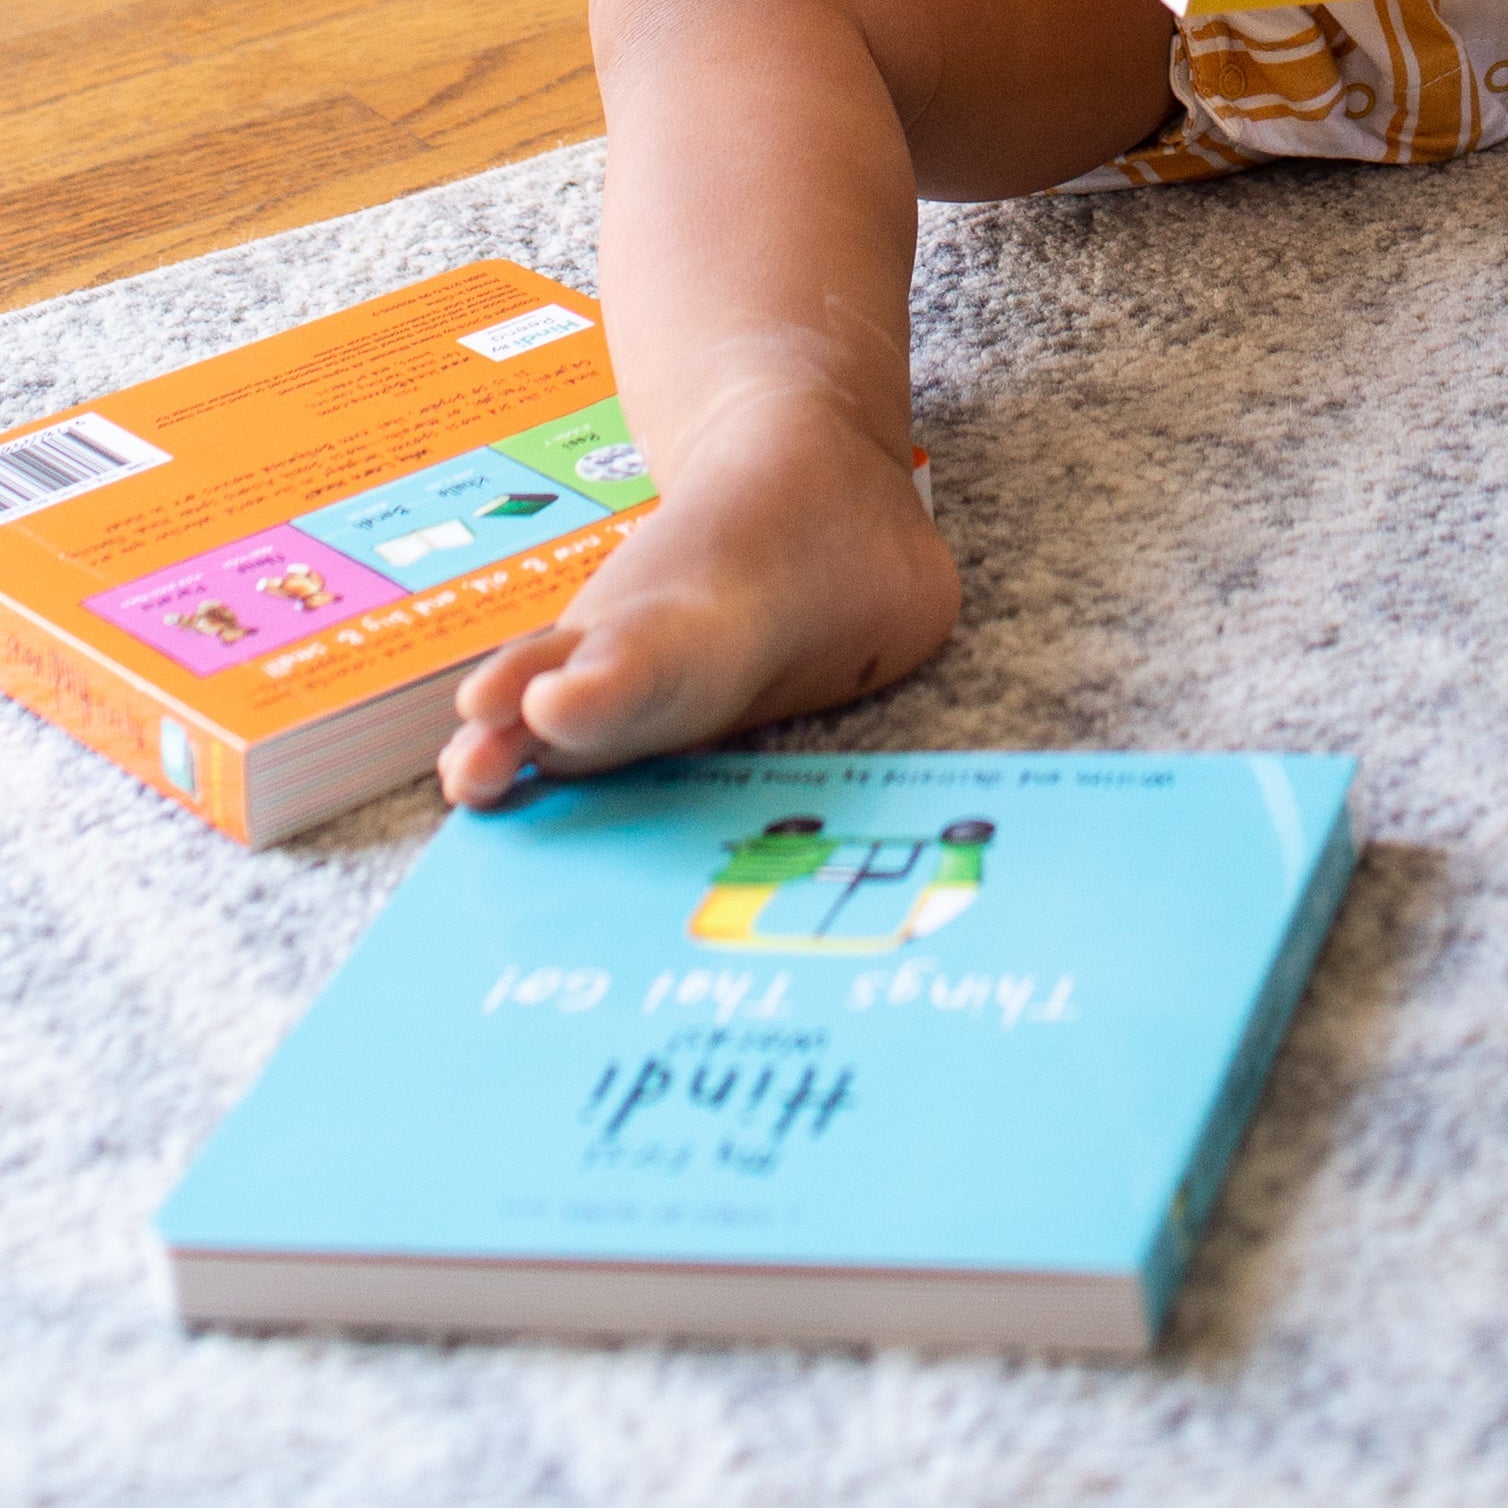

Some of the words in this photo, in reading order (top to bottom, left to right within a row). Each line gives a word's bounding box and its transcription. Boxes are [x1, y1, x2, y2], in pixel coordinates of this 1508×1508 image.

[480, 961, 616, 1016] Go!
[848, 954, 1080, 1028] Things
[578, 1057, 854, 1146] Hindi
